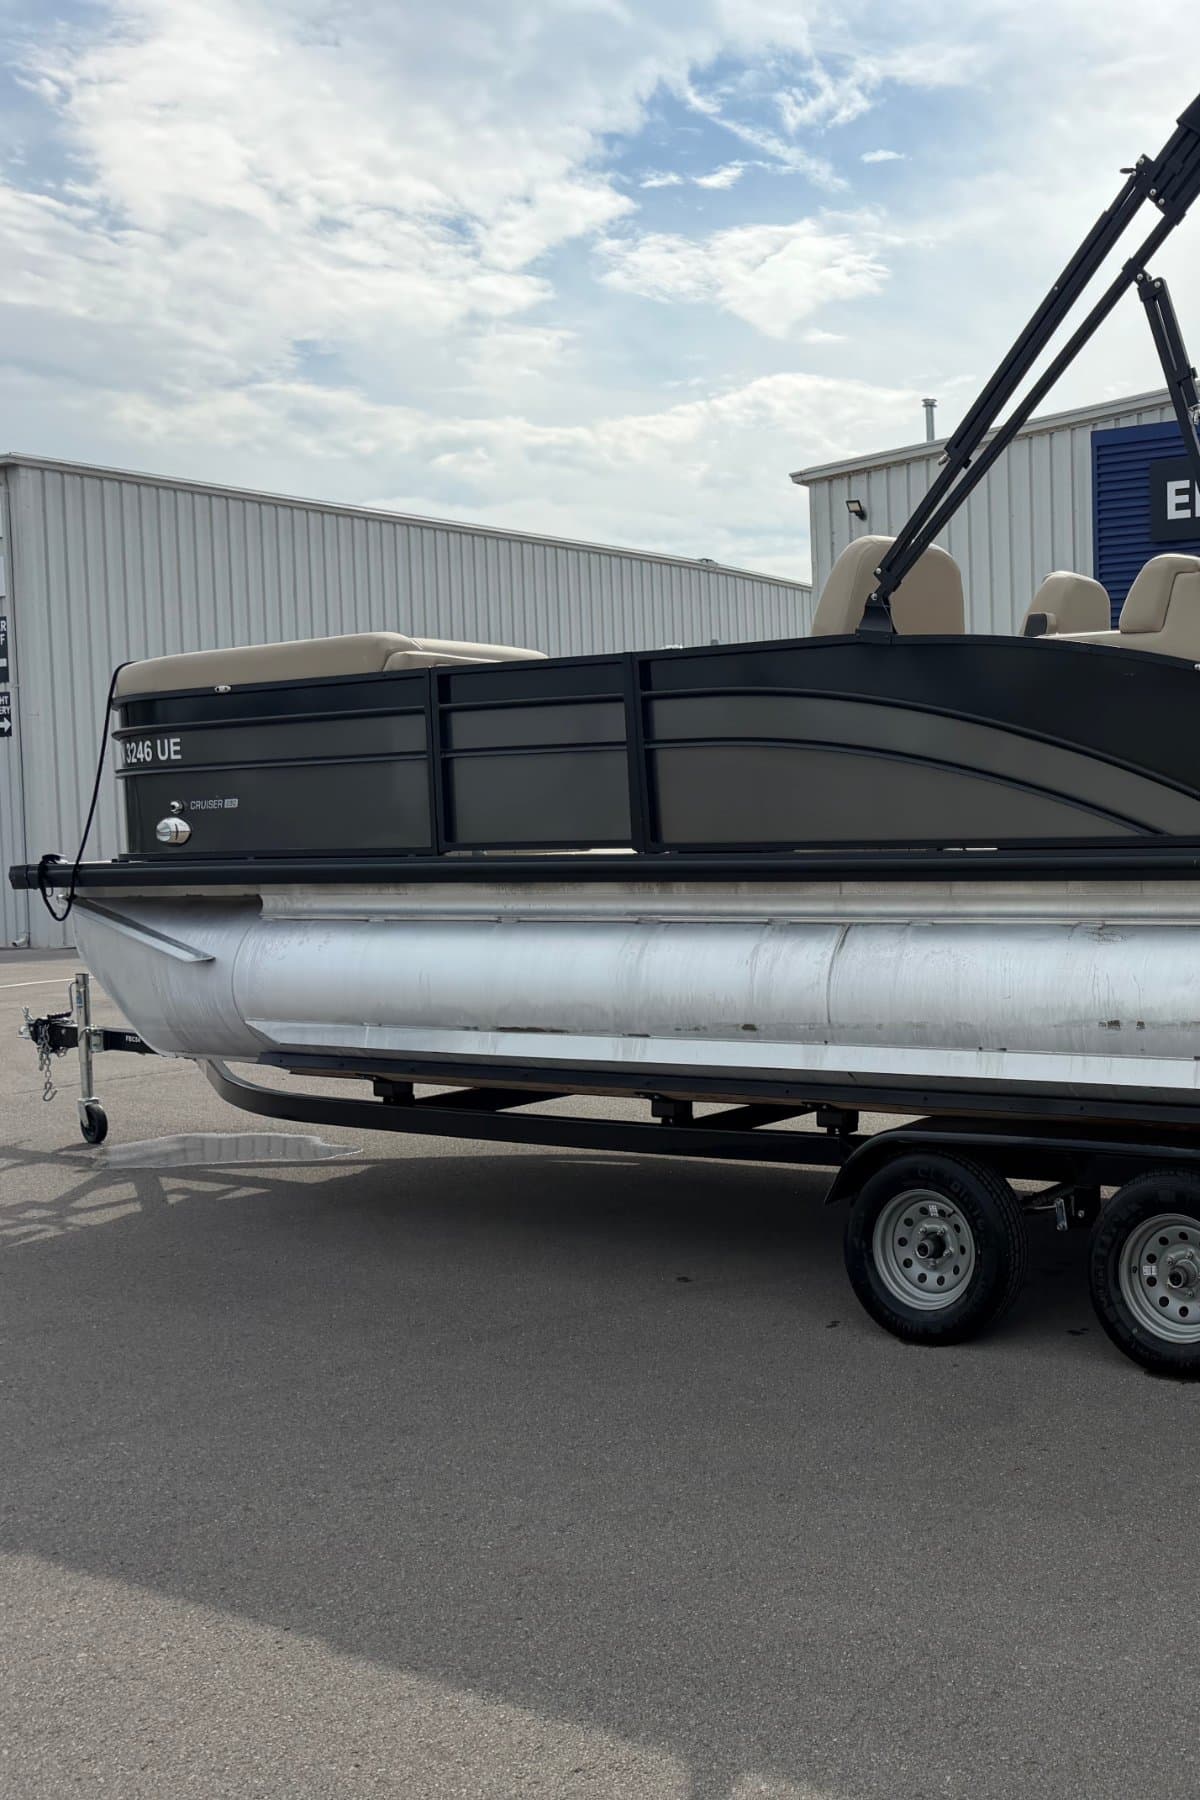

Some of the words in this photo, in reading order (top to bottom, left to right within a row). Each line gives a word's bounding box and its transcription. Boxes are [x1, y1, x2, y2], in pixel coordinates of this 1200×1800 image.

[126, 740, 153, 763] 3246
[156, 738, 182, 760] UE
[190, 799, 224, 810] CRUISER
